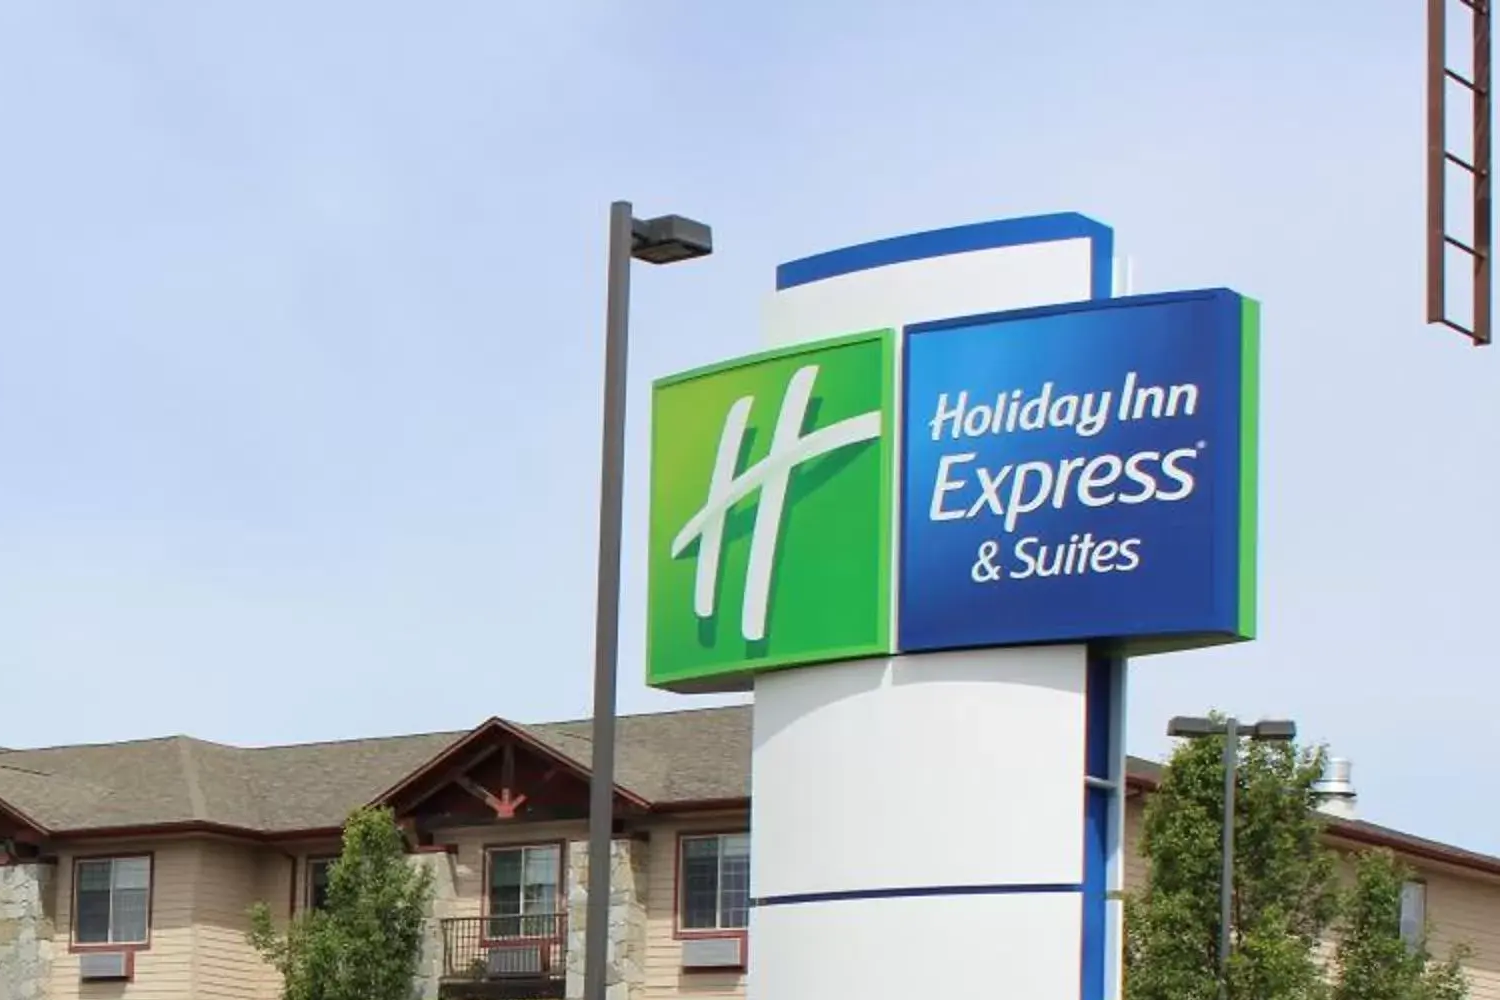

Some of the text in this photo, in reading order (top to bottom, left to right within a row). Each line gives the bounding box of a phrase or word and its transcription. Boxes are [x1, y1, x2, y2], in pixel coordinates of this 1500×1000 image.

[929, 371, 1198, 441] Holiday Inn
[929, 448, 1198, 533] Express
[971, 533, 1141, 583] & Suites
